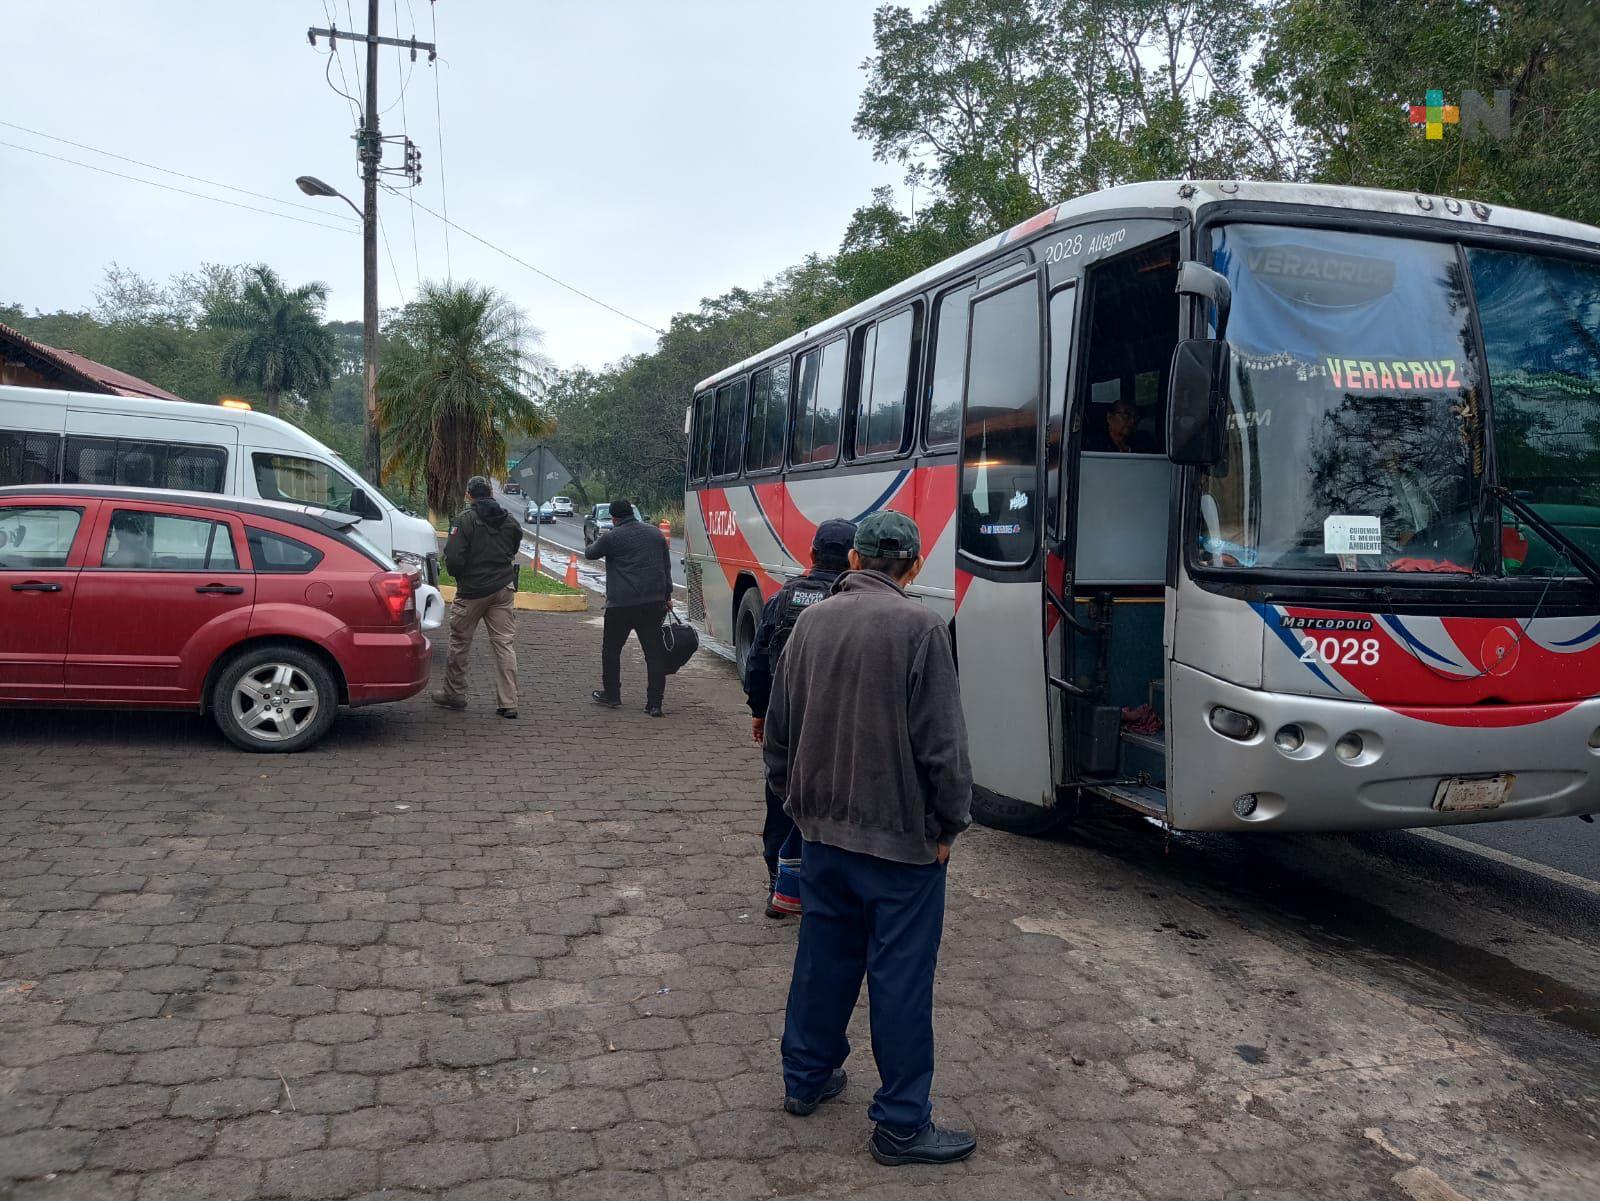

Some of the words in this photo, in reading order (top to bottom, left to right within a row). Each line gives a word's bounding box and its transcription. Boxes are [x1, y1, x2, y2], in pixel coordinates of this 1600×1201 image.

[1045, 234, 1083, 265] 2028
[1087, 228, 1126, 256] Allegro
[1326, 357, 1461, 390] VERACRUZ
[1348, 542, 1381, 551] AMBIENTE
[1282, 616, 1372, 630] Marcopolo
[1299, 636, 1380, 666] 2028
